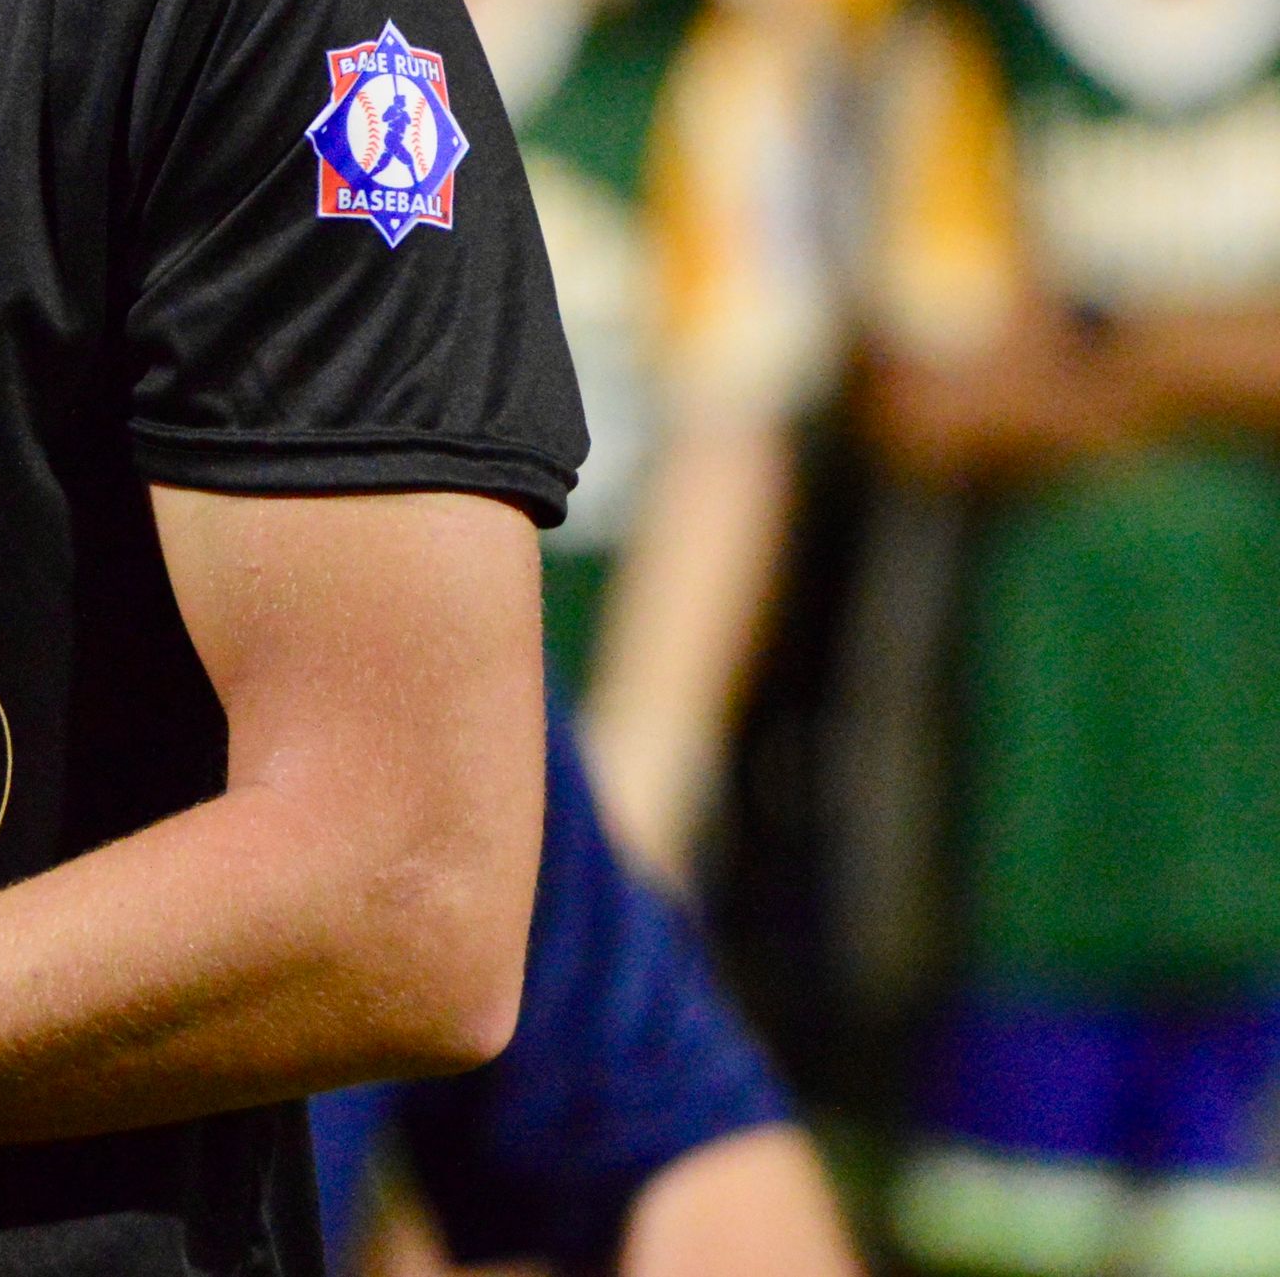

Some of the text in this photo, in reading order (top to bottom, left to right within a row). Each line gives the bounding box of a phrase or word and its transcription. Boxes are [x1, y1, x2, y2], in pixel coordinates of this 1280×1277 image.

[339, 51, 441, 82] BABE RUTH
[337, 188, 444, 217] BASEBALL
